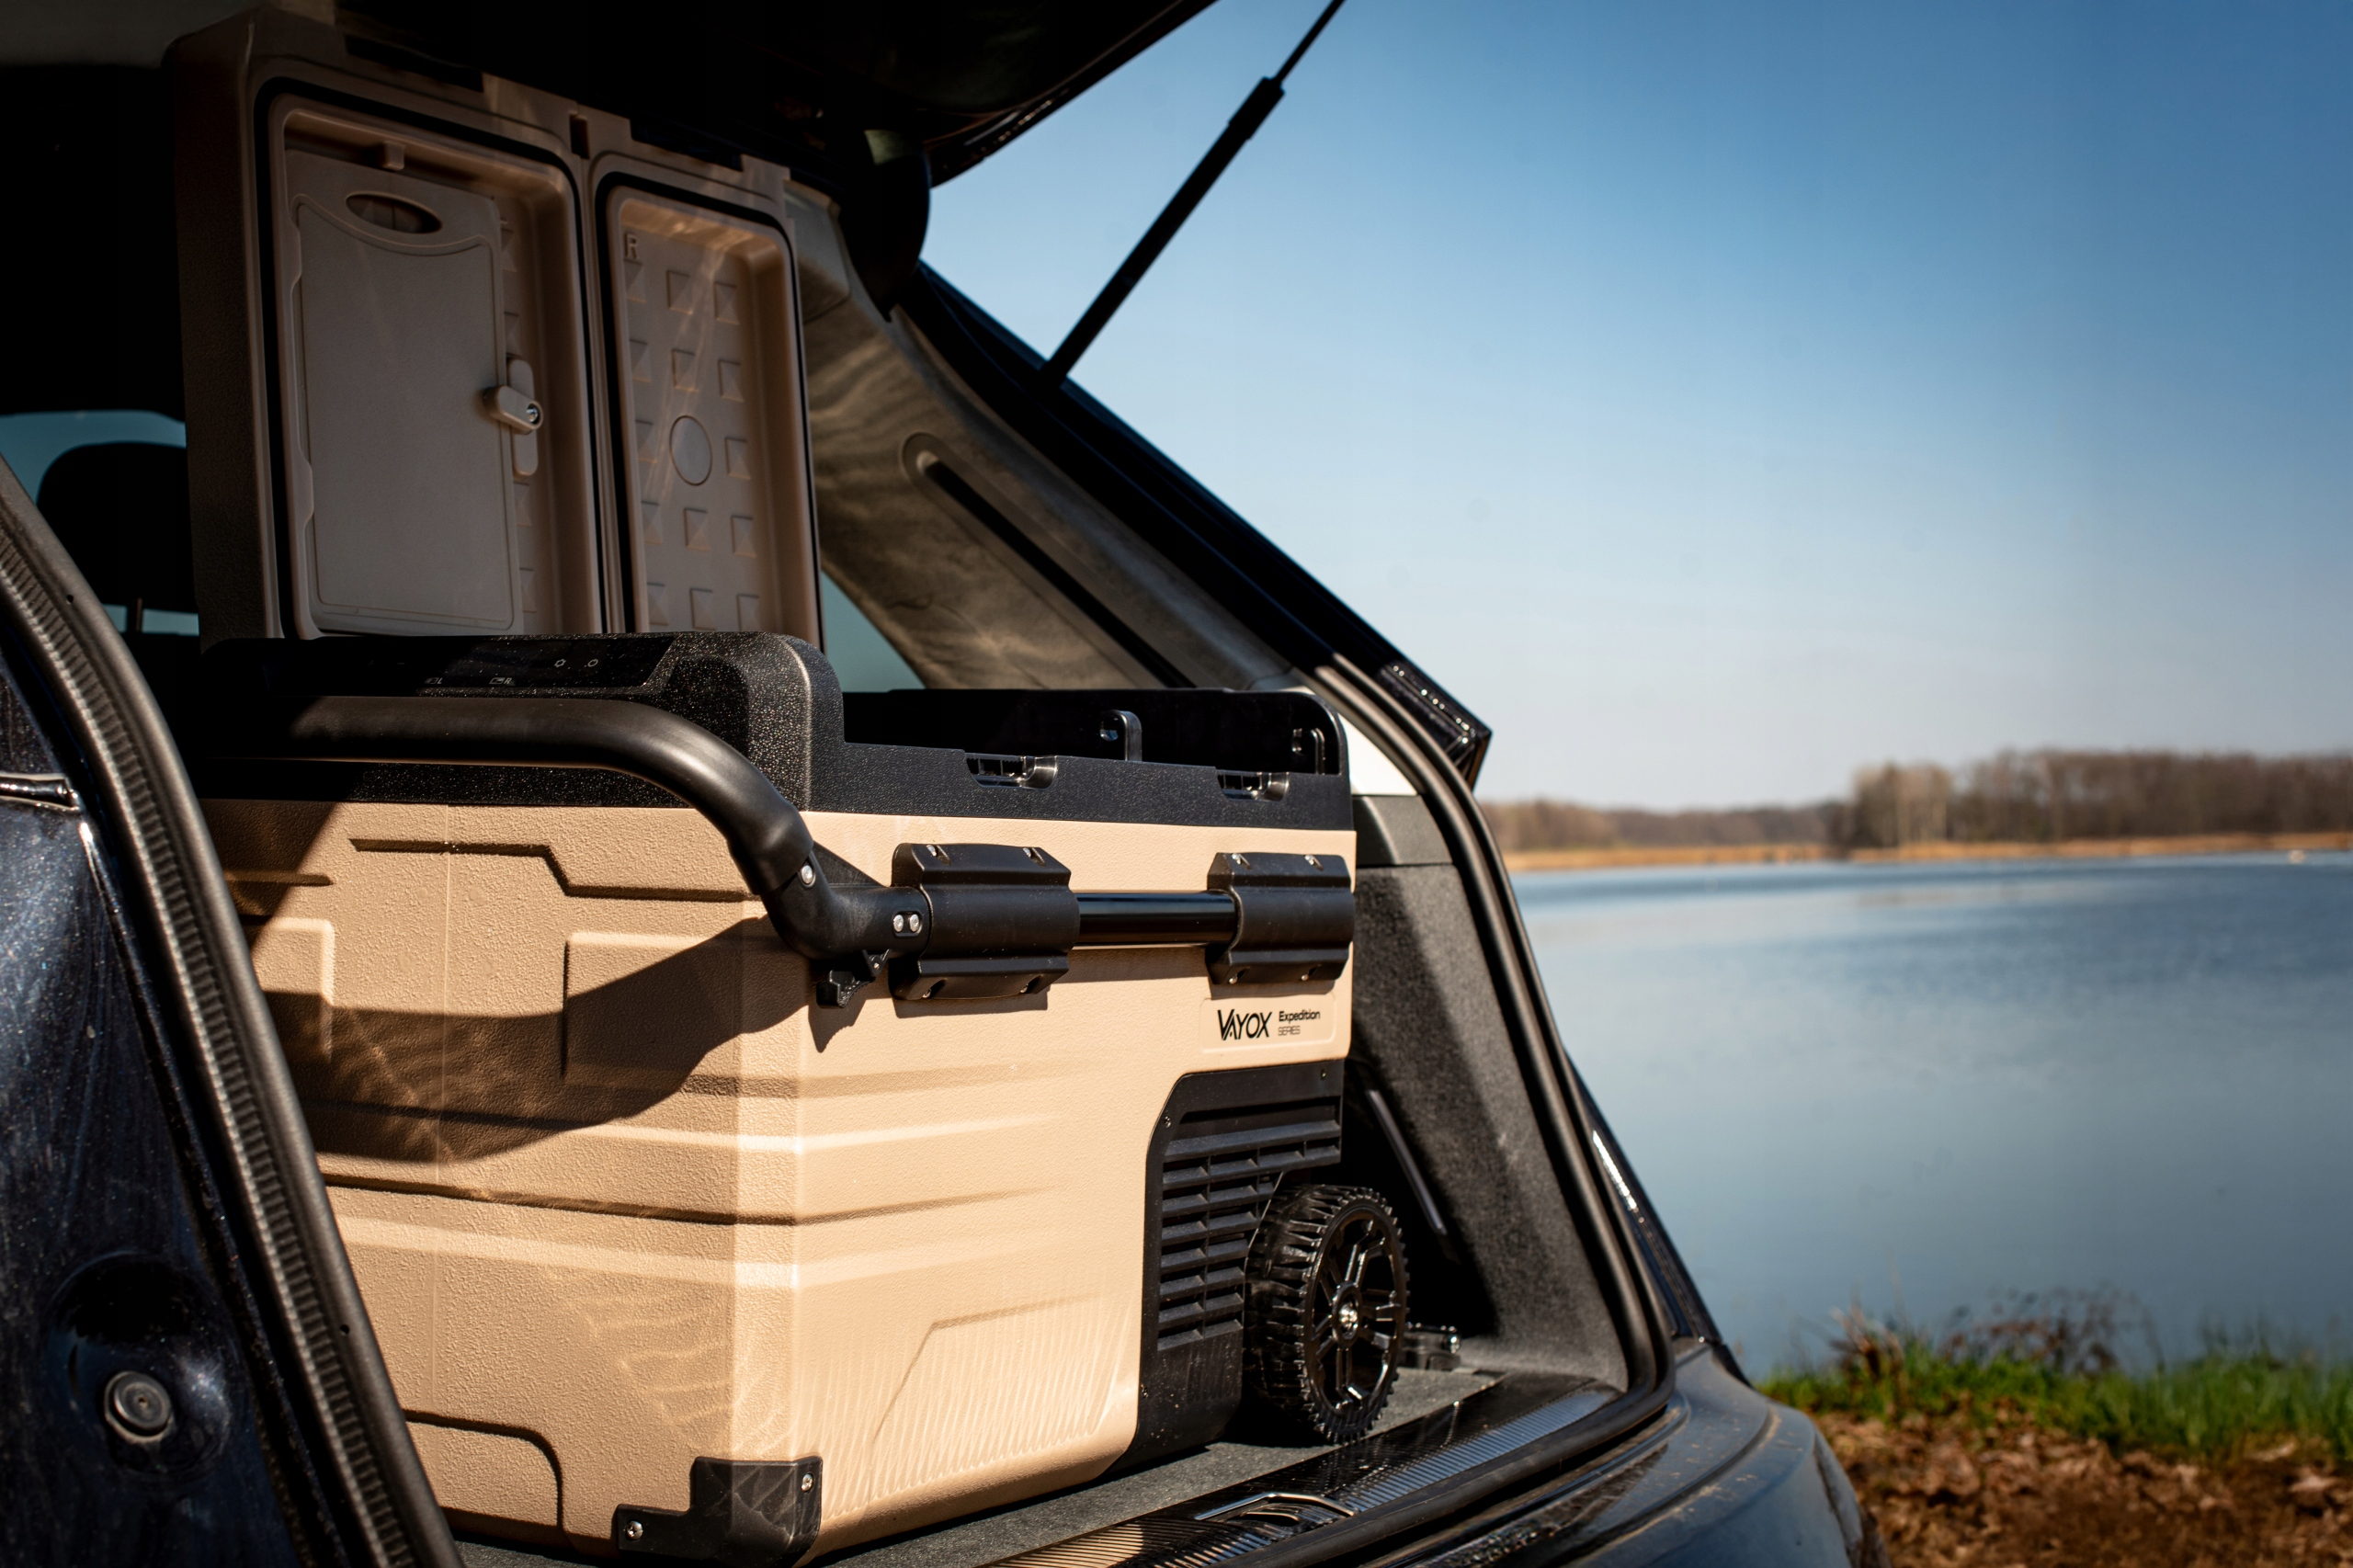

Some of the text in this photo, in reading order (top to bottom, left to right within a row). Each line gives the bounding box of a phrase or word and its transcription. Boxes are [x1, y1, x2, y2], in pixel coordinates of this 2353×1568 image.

[624, 232, 638, 259] R
[1217, 1008, 1321, 1041] VAYOX Expedition
[1278, 1025, 1301, 1036] SERIES
